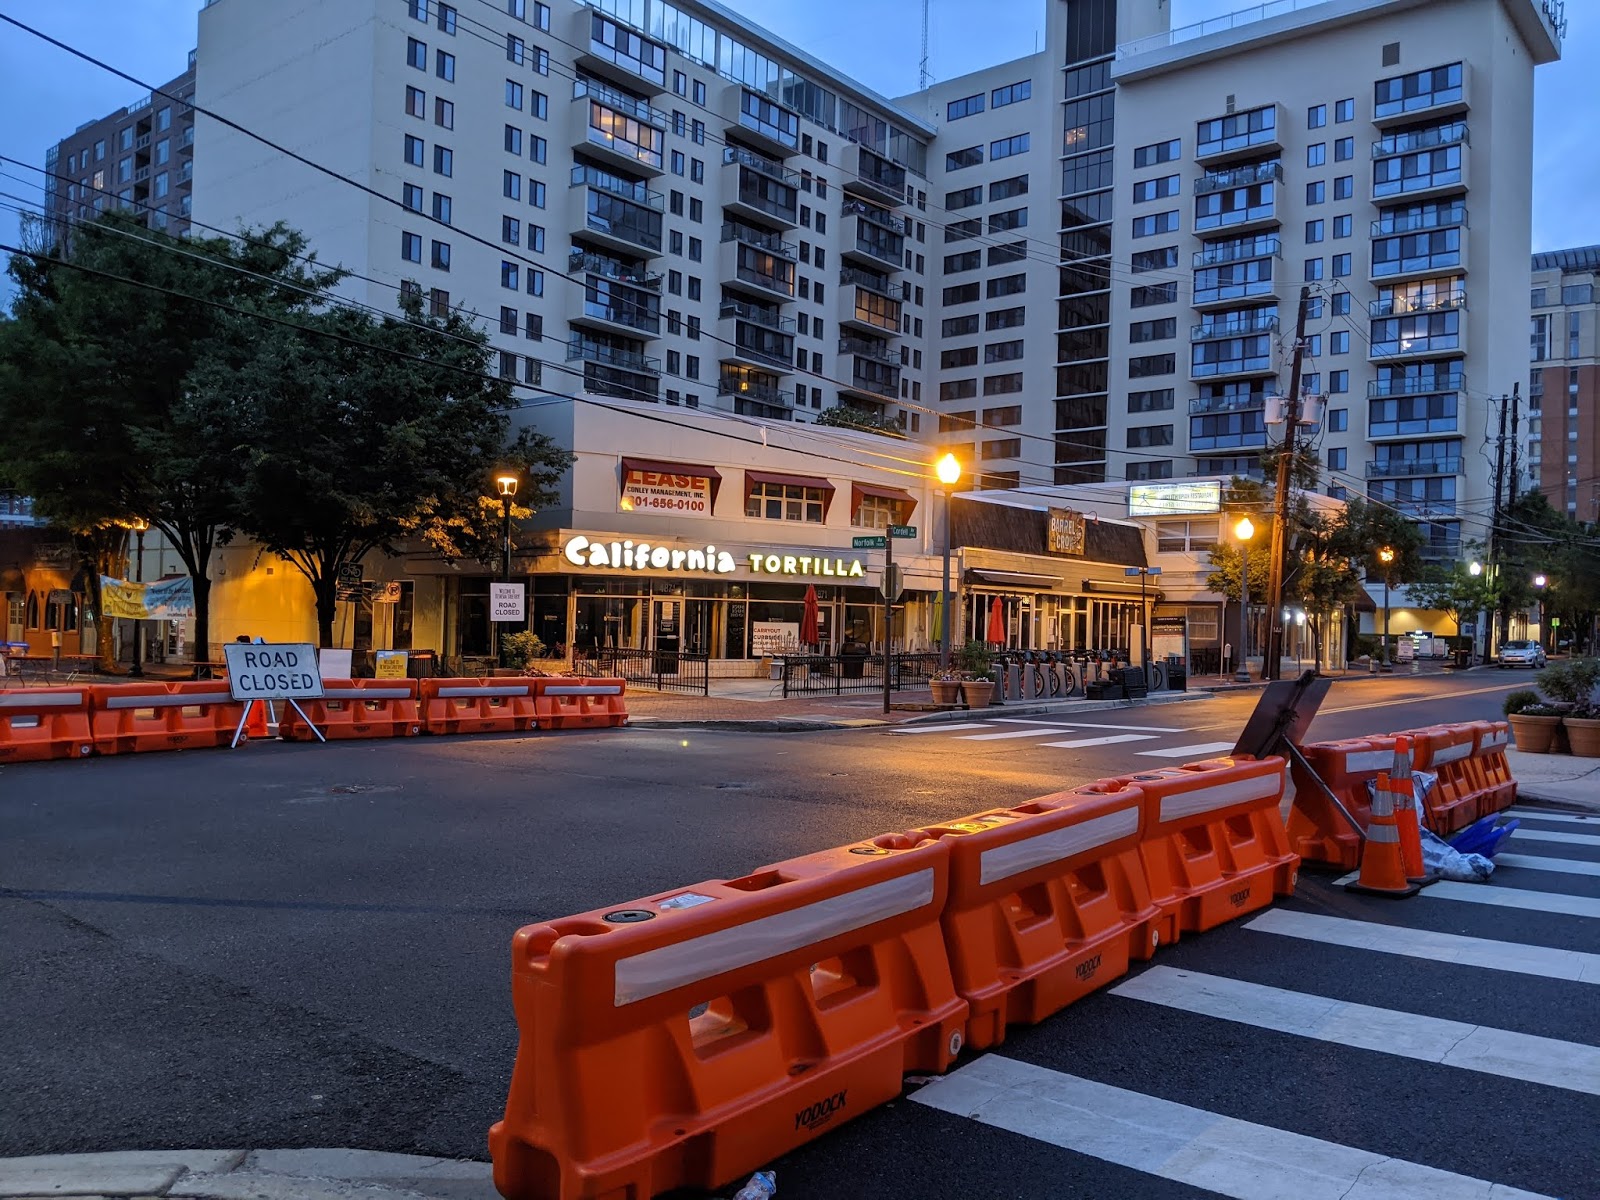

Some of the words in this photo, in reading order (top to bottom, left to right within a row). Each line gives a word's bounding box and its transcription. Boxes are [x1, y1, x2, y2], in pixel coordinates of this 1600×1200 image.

[627, 471, 705, 490] LEASE
[627, 486, 649, 494] CONLEY
[650, 488, 692, 498] MANAGEMENT,
[693, 491, 706, 499] INC.
[633, 496, 705, 512] 01-656-0100
[893, 527, 909, 536] Cordell
[1051, 517, 1076, 535] BARREL
[854, 538, 875, 547] Norfolk
[565, 535, 737, 573] California
[749, 553, 865, 577] TORTILLA
[245, 651, 298, 669] ROAD
[239, 673, 314, 691] CLOSED
[795, 1089, 848, 1131] YODOCK
